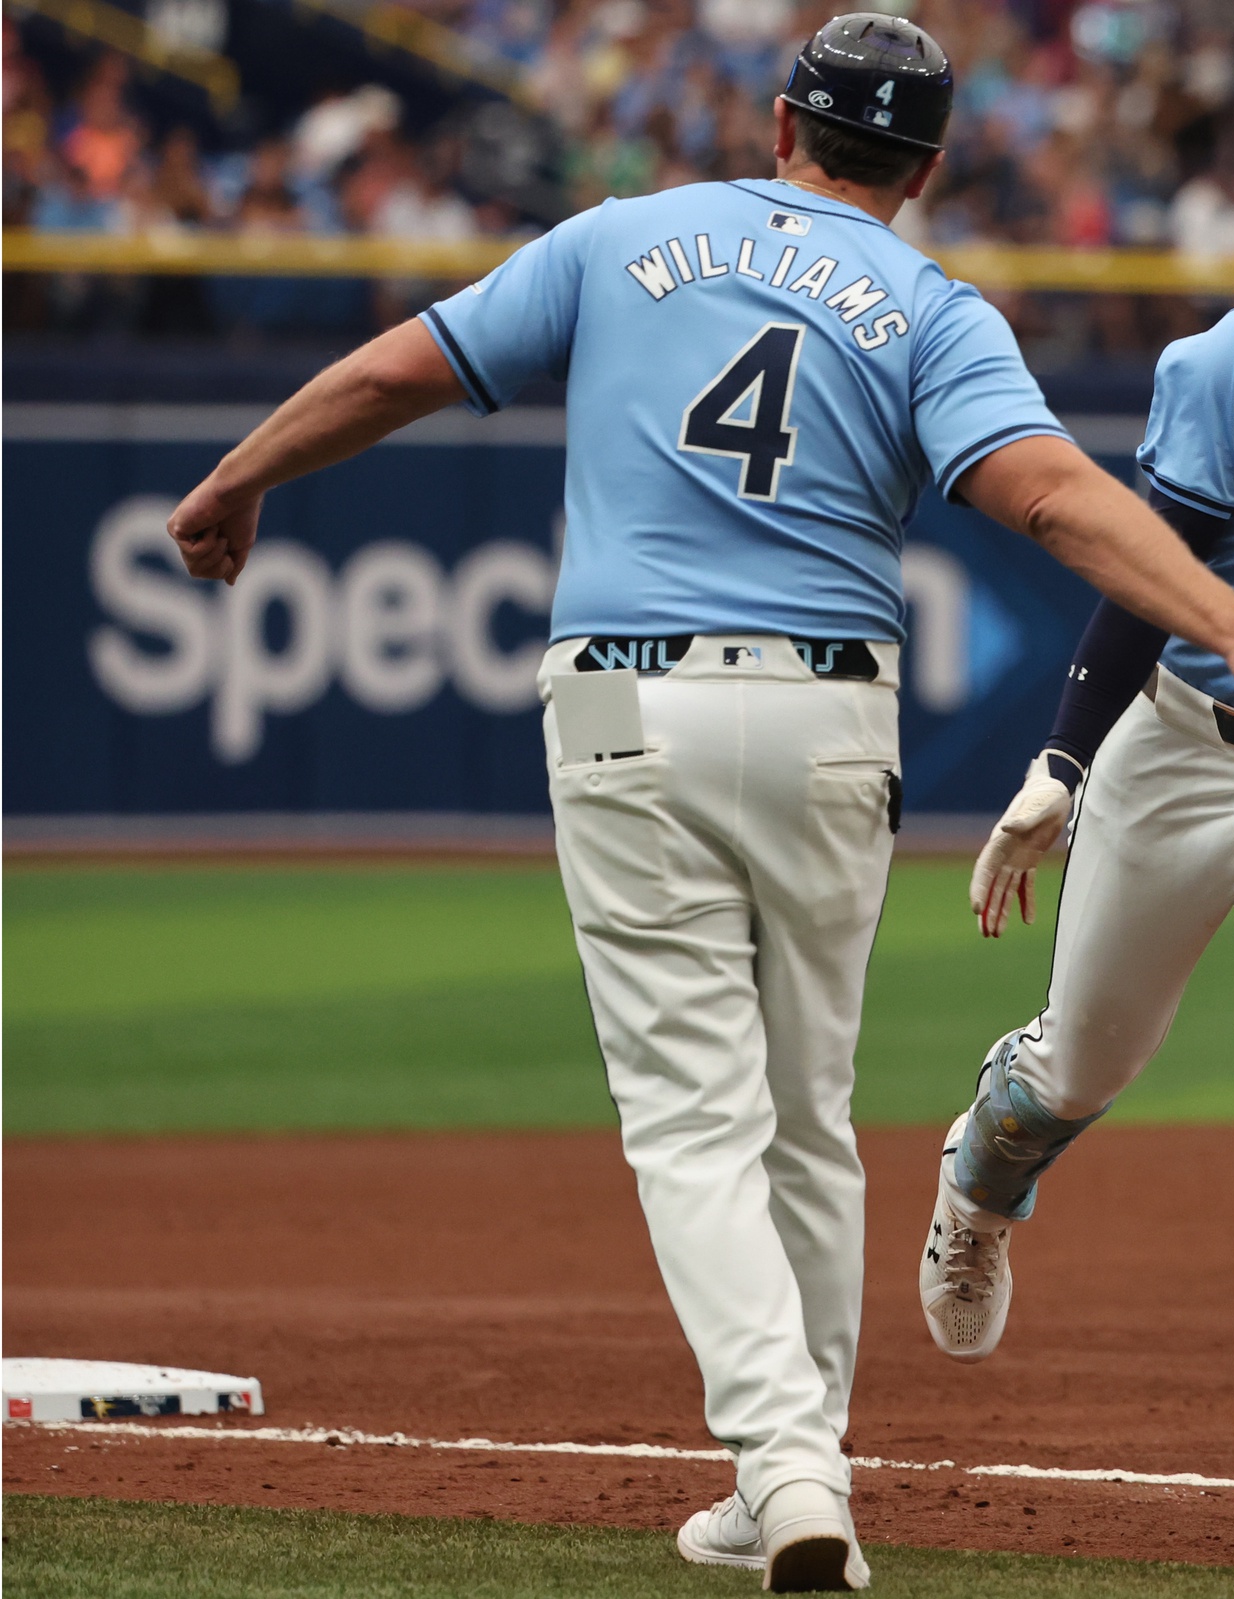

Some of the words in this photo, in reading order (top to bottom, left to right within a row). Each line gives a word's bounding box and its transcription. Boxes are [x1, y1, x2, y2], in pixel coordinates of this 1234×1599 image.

[875, 80, 895, 106] 4
[626, 233, 909, 351] WILLIAMS
[677, 321, 807, 503] 4
